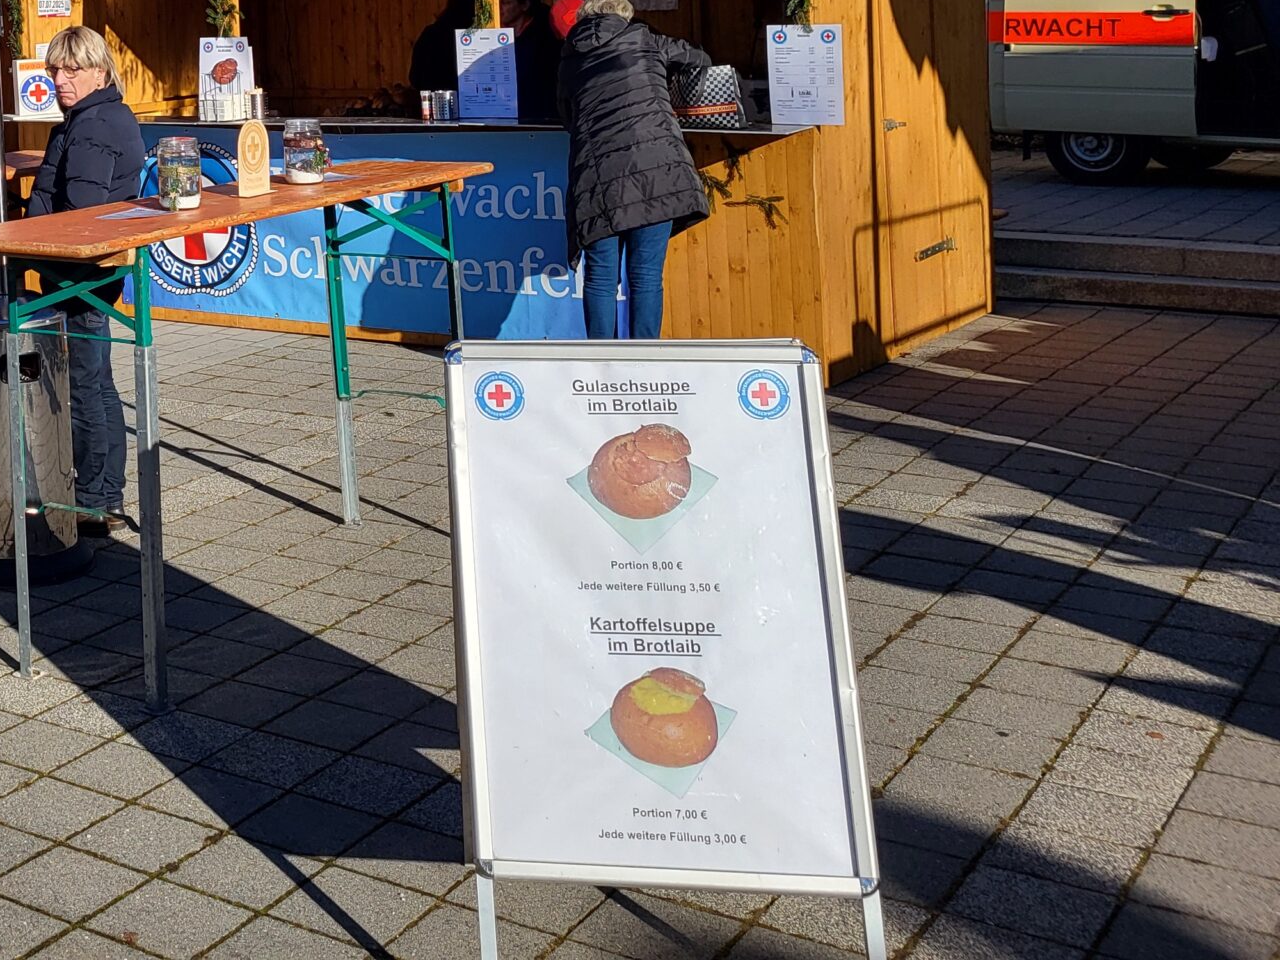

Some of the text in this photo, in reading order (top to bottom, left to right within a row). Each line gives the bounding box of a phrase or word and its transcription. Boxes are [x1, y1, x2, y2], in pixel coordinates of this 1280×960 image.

[150, 228, 248, 284] ASSER WACHT
[572, 379, 690, 395] Gulaschsuppe
[587, 398, 677, 411] im Brotlaib
[610, 560, 683, 571] Portion 8,00 €
[578, 581, 720, 593] Jede weitere Füllung 3,50 €
[590, 617, 715, 634] Kartoffelsuppe
[608, 638, 701, 653] im Brotlaib
[632, 807, 707, 820] Portion 7,00 €
[599, 829, 747, 845] Jede weitere Füllung 3,00 €
